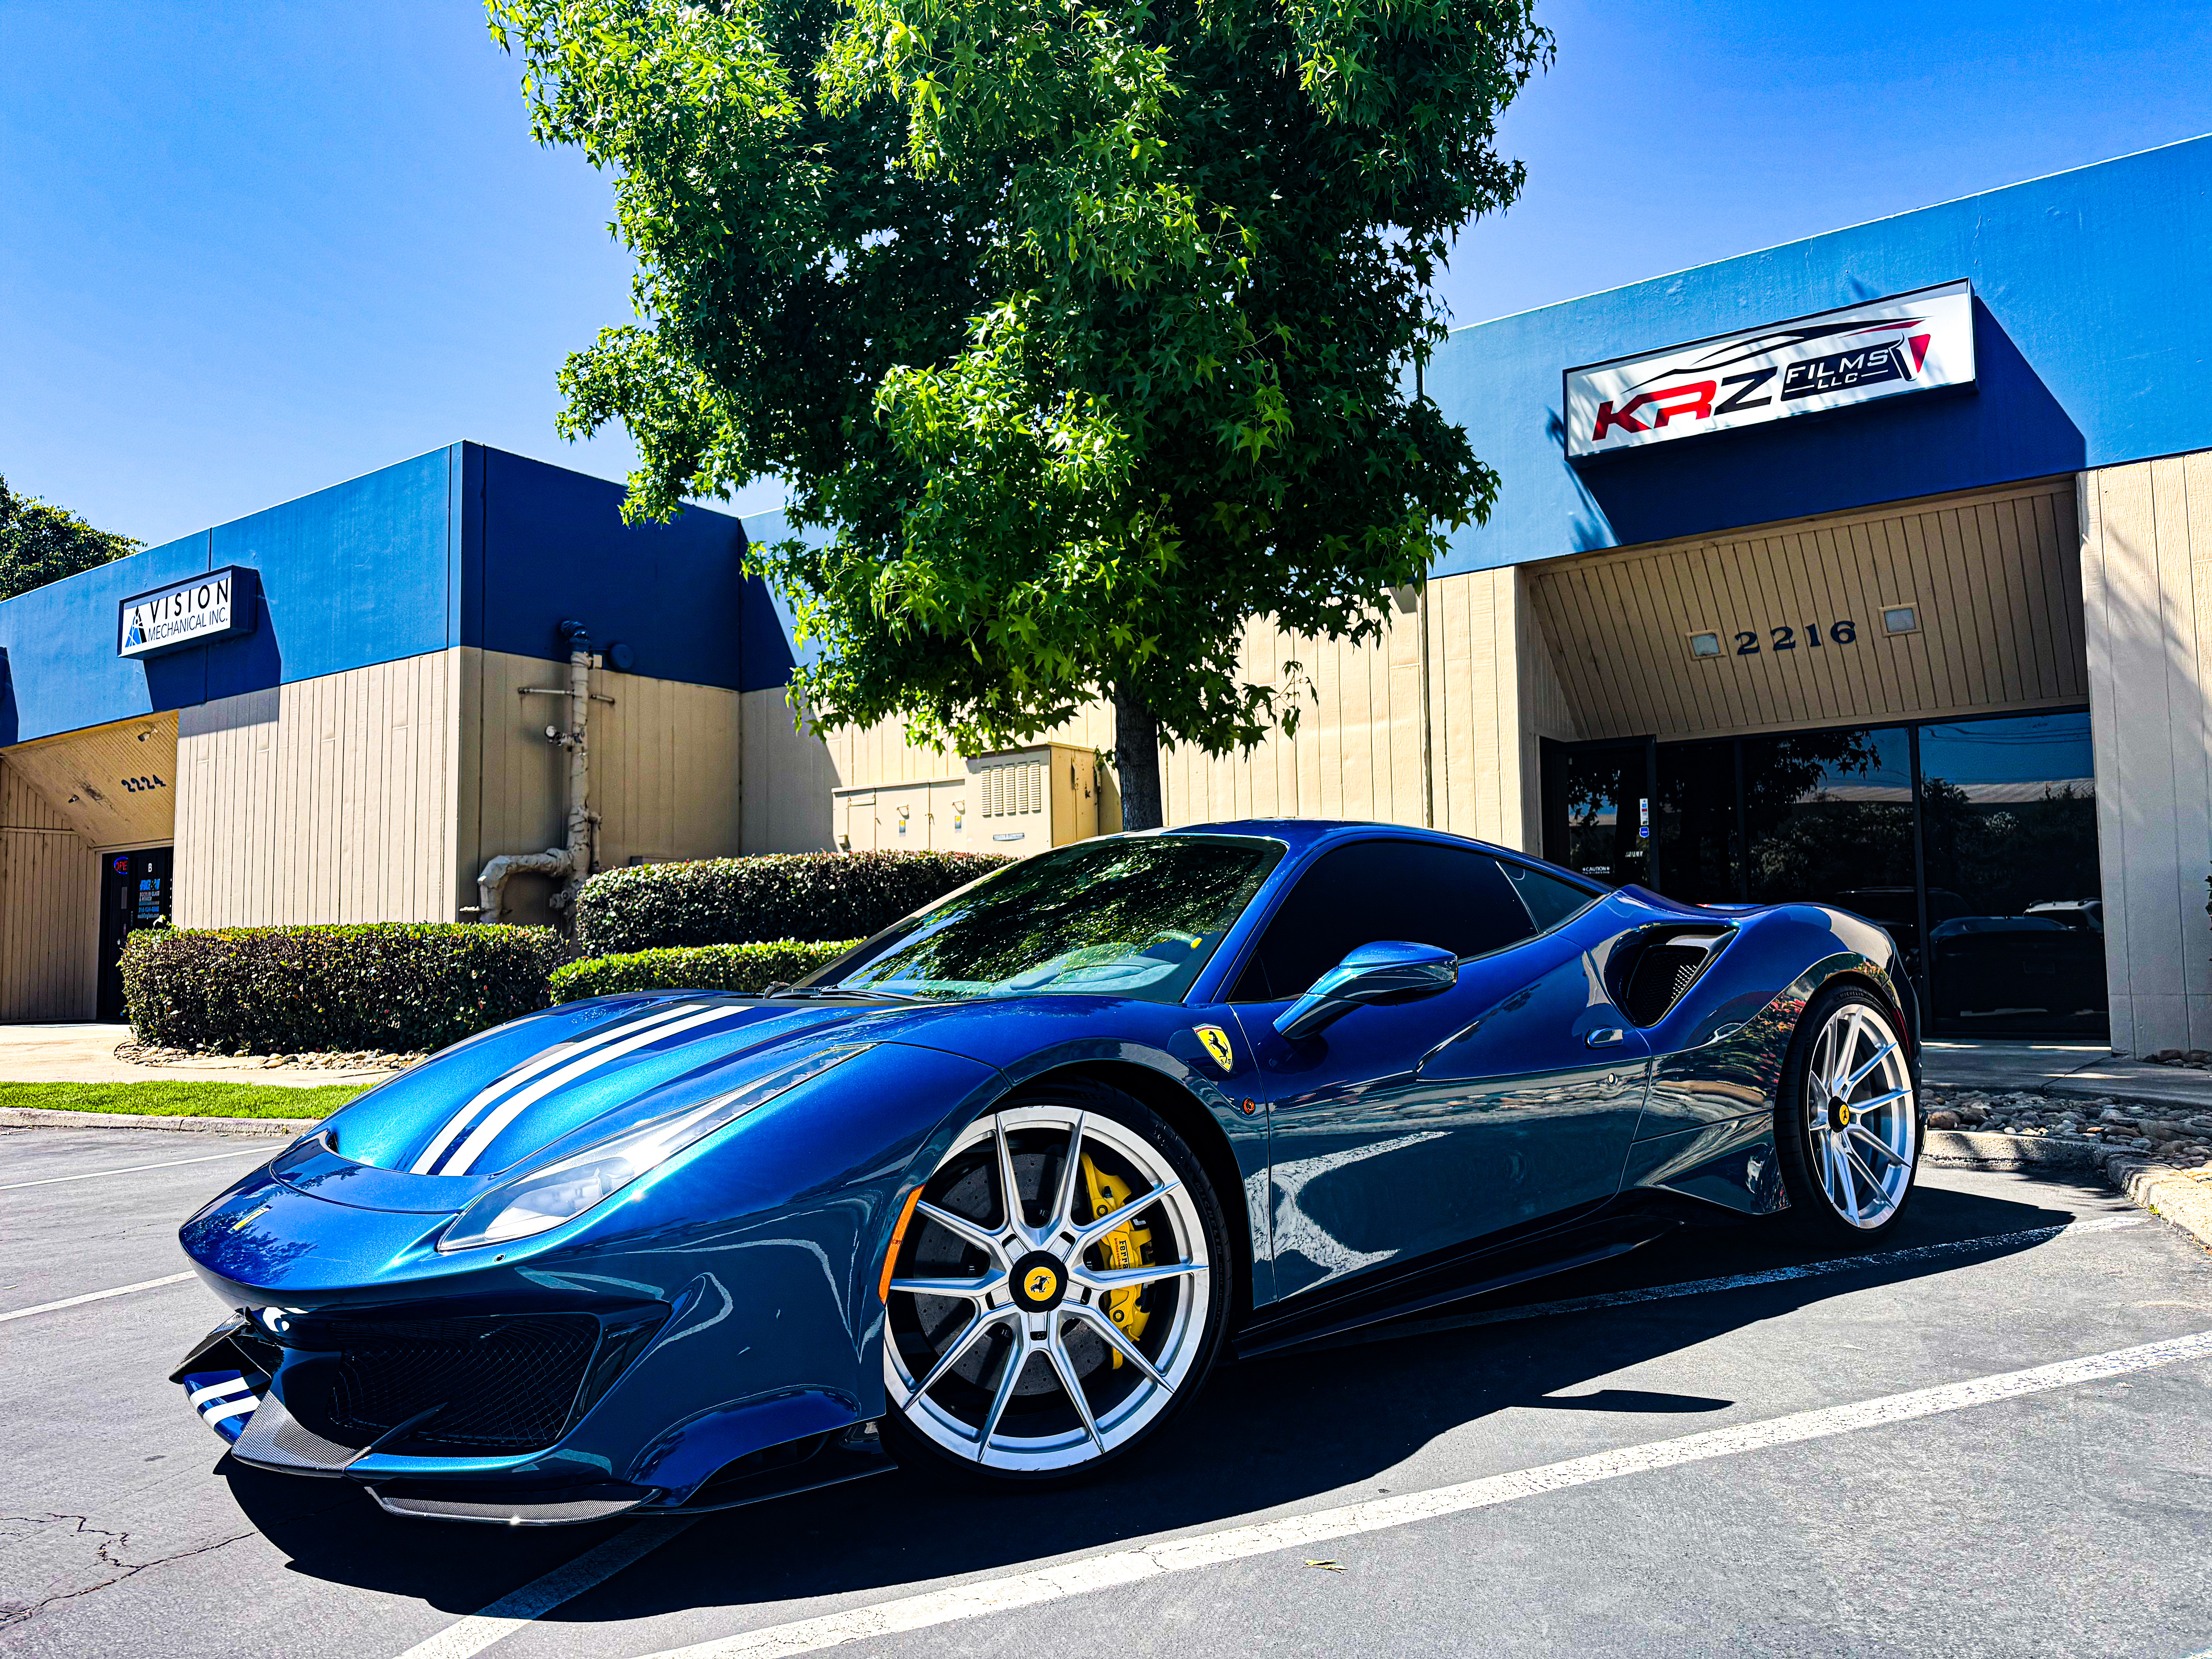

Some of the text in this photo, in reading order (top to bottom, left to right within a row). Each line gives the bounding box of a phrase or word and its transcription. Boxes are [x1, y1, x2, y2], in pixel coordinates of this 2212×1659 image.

[1786, 349, 1889, 384] FILMS
[1817, 372, 1858, 389] LLC
[1592, 366, 1778, 441] KRZ
[150, 578, 228, 623] VISION
[148, 607, 228, 642] MECHANICAL INC.
[1734, 620, 1857, 655] 2216
[121, 774, 166, 792] 2224
[115, 860, 127, 871] OPE
[148, 863, 152, 872] B
[1195, 1182, 1222, 1254] MICHELIN
[1119, 1240, 1129, 1269] Ferra
